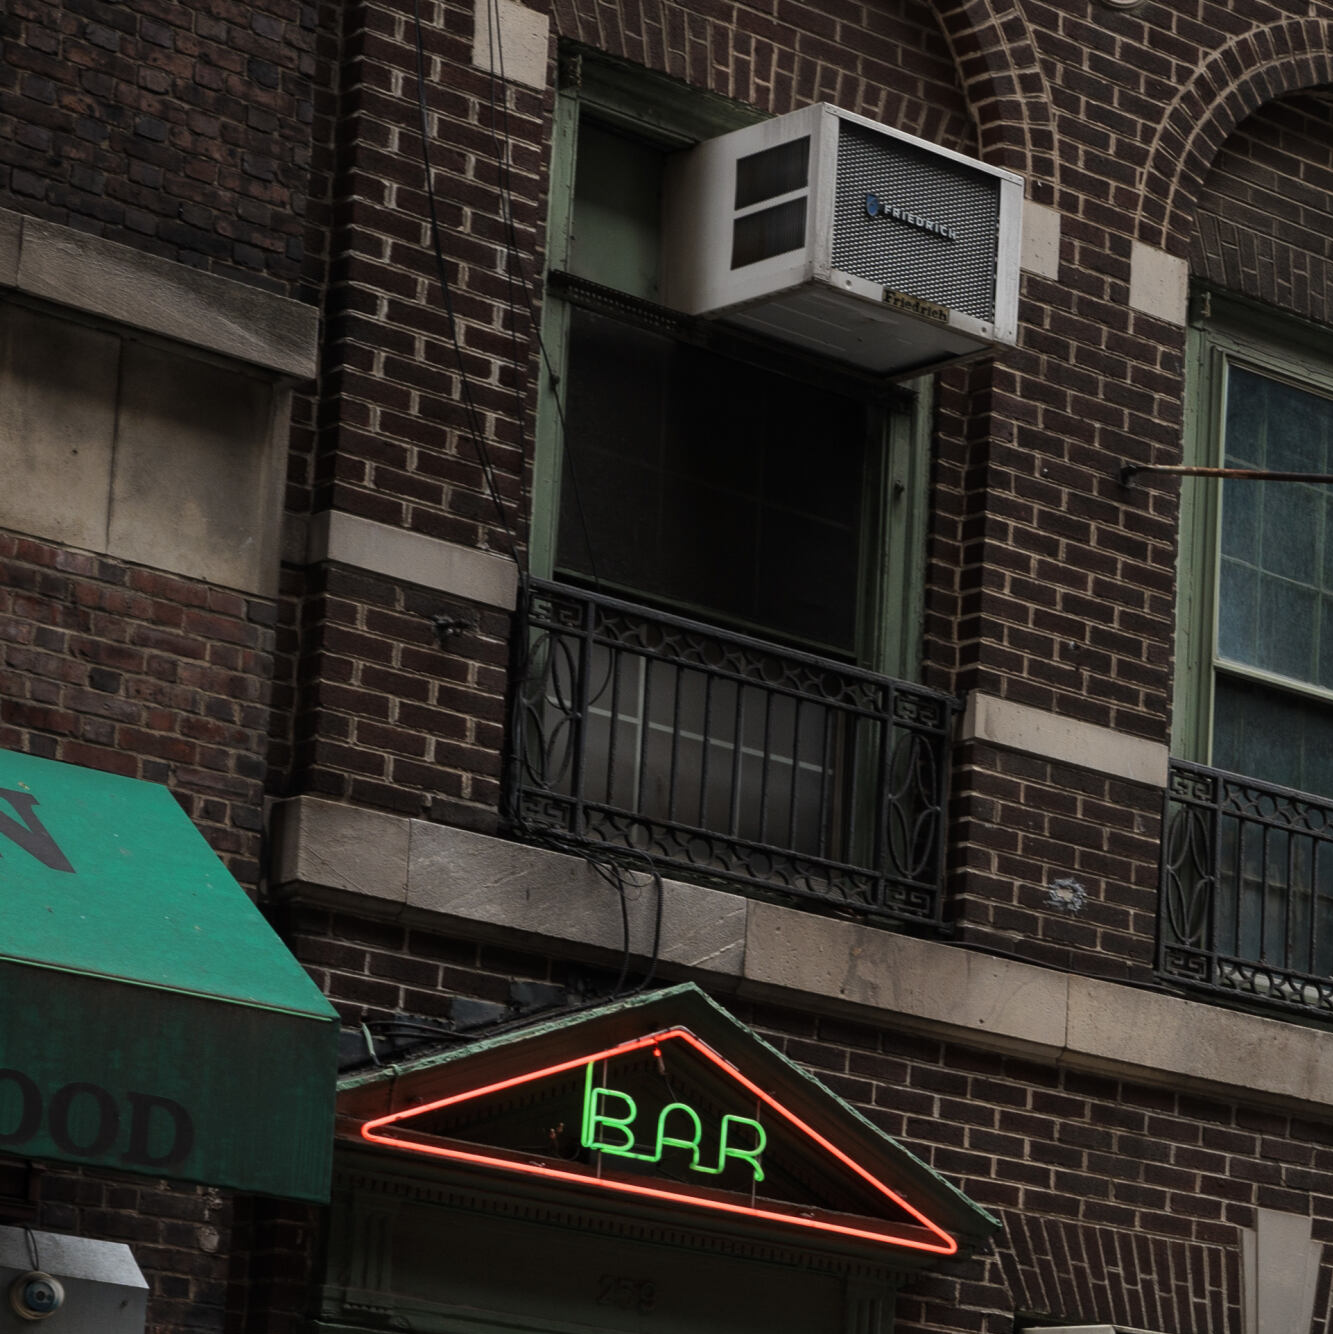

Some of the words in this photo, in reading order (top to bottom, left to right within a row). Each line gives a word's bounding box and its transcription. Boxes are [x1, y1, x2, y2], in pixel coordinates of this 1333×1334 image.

[883, 204, 957, 240] FRIEDRICH
[885, 289, 948, 321] Friedrich
[580, 1064, 768, 1182] BAR
